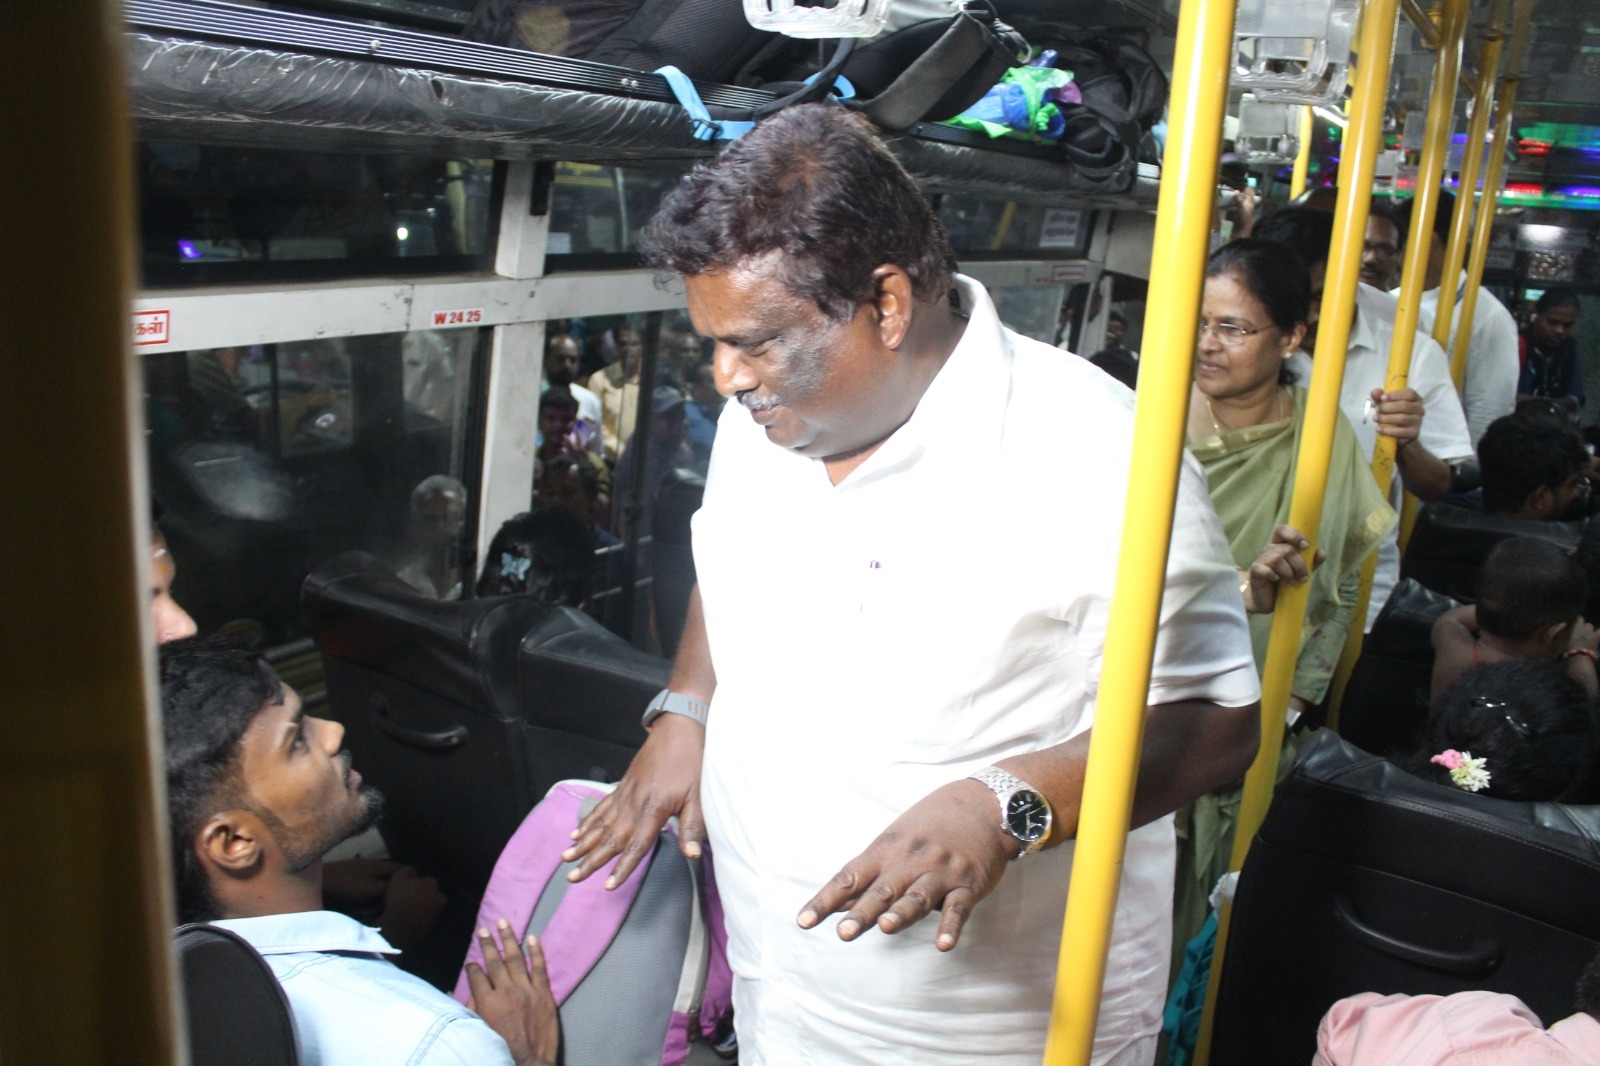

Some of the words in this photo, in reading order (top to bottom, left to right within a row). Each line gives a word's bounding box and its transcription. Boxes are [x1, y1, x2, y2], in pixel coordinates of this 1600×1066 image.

[135, 316, 163, 335] கள்
[434, 312, 447, 325] W
[449, 311, 464, 324] 24
[466, 310, 481, 322] 25
